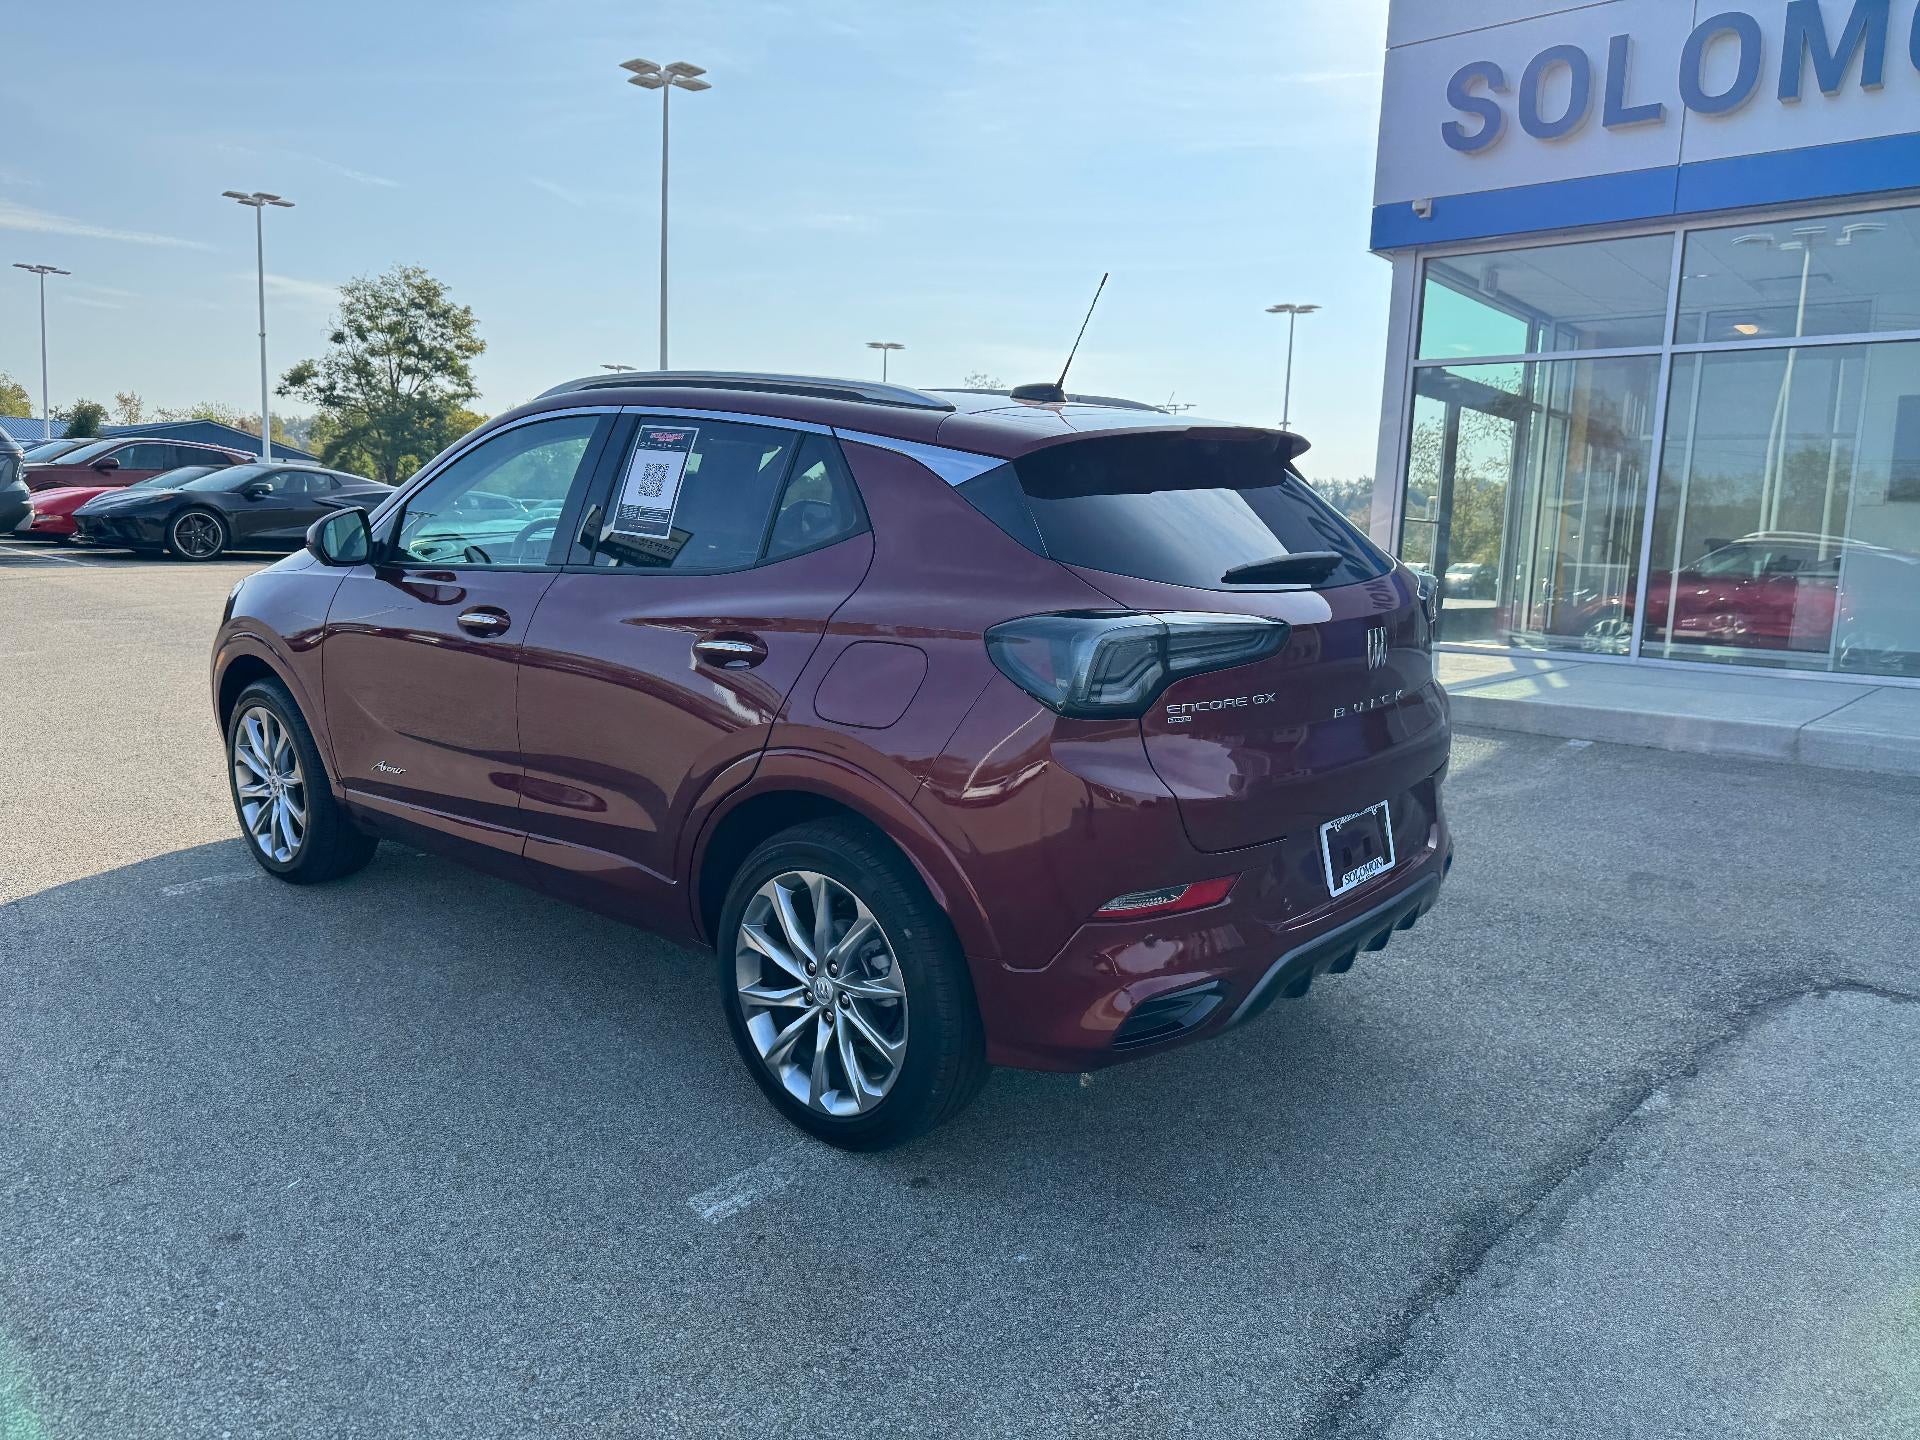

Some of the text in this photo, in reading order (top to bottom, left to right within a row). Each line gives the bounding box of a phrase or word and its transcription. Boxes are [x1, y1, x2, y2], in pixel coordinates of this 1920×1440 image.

[1441, 0, 1920, 155] SOLOM
[1166, 692, 1276, 714] ENCORE GX
[1333, 689, 1404, 719] BUICK
[371, 760, 407, 775] Avenir
[1344, 857, 1384, 886] SOLOMON
